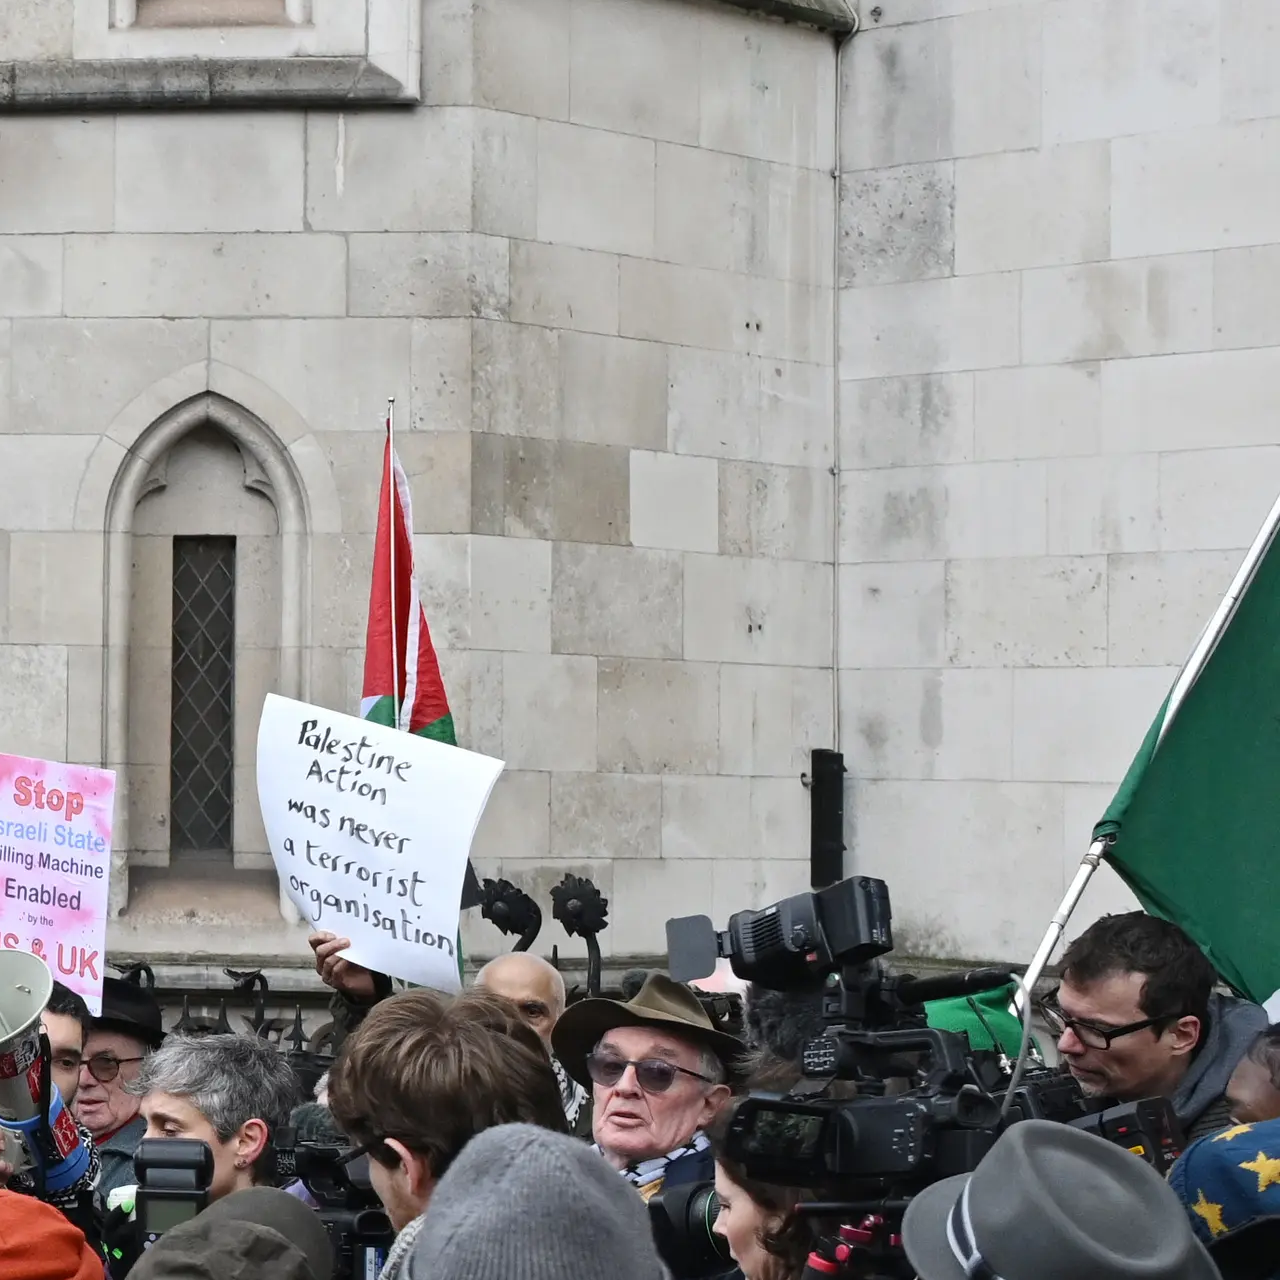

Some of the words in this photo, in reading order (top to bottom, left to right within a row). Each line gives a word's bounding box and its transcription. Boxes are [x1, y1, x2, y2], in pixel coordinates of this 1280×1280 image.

[298, 719, 413, 782] Palestine
[13, 775, 84, 822] Stop
[306, 759, 387, 805] Action
[54, 824, 106, 853] State
[288, 798, 330, 829] was
[340, 815, 412, 854] never
[39, 852, 104, 879] Machine
[284, 837, 295, 857] a
[306, 839, 427, 907] terrorist
[5, 877, 82, 911] Enabled
[289, 874, 454, 957] organisation
[27, 913, 39, 927] by
[40, 914, 54, 927] the
[57, 943, 99, 981] UK
